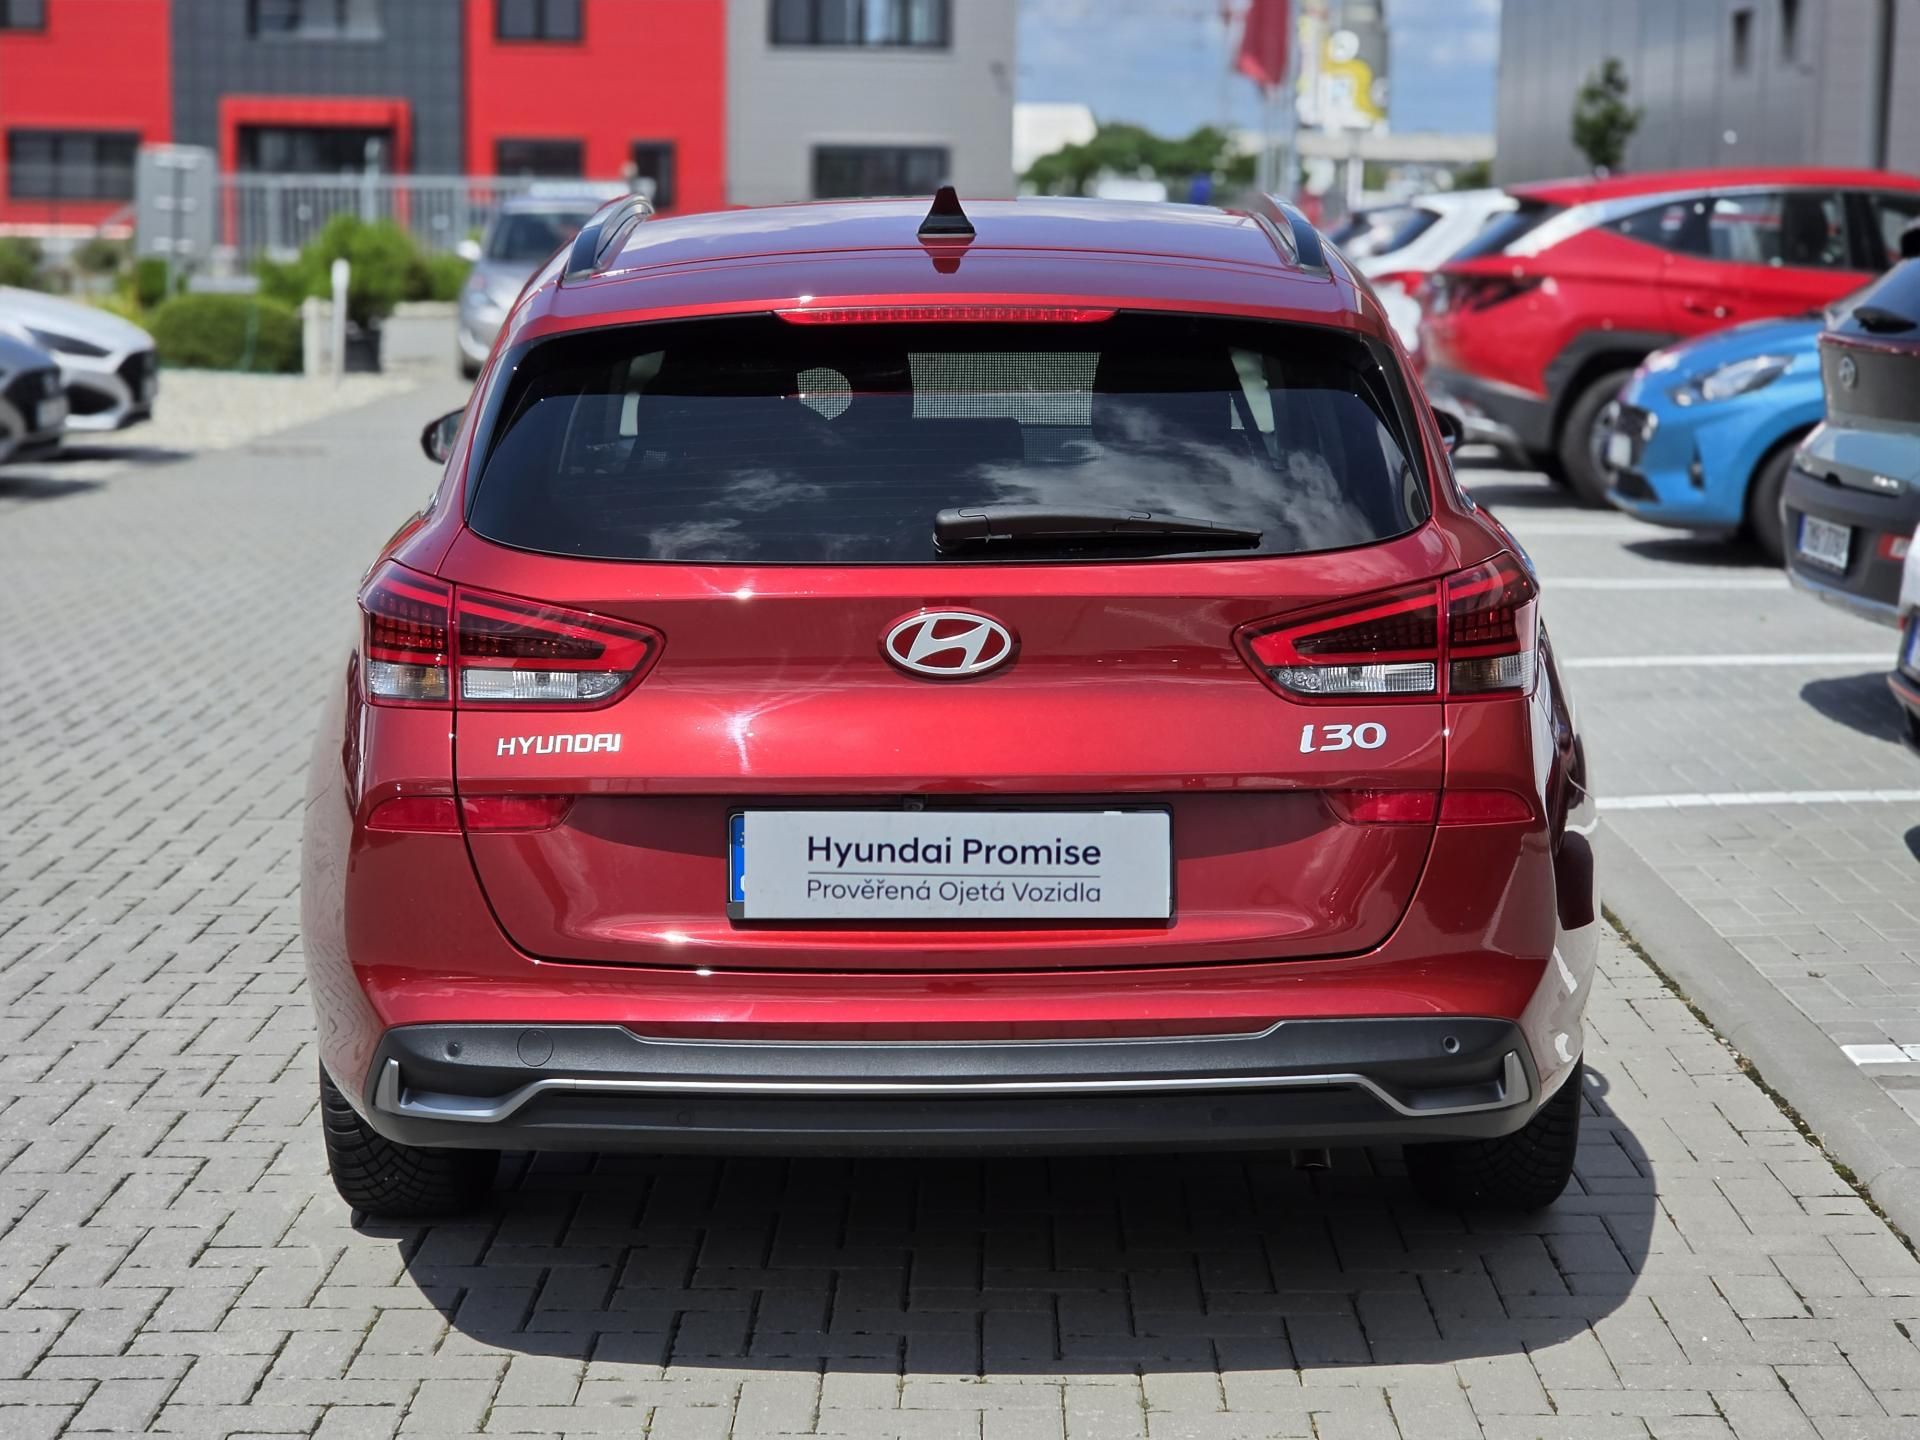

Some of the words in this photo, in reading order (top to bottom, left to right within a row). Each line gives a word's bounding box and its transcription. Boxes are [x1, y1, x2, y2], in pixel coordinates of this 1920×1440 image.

[496, 733, 622, 756] HYUNDAI
[807, 835, 952, 869] Hyundai
[962, 837, 1102, 866] Promise
[807, 878, 931, 901] Prověřená
[938, 880, 1005, 906] Ojetá
[1011, 880, 1102, 903] Vozidla
